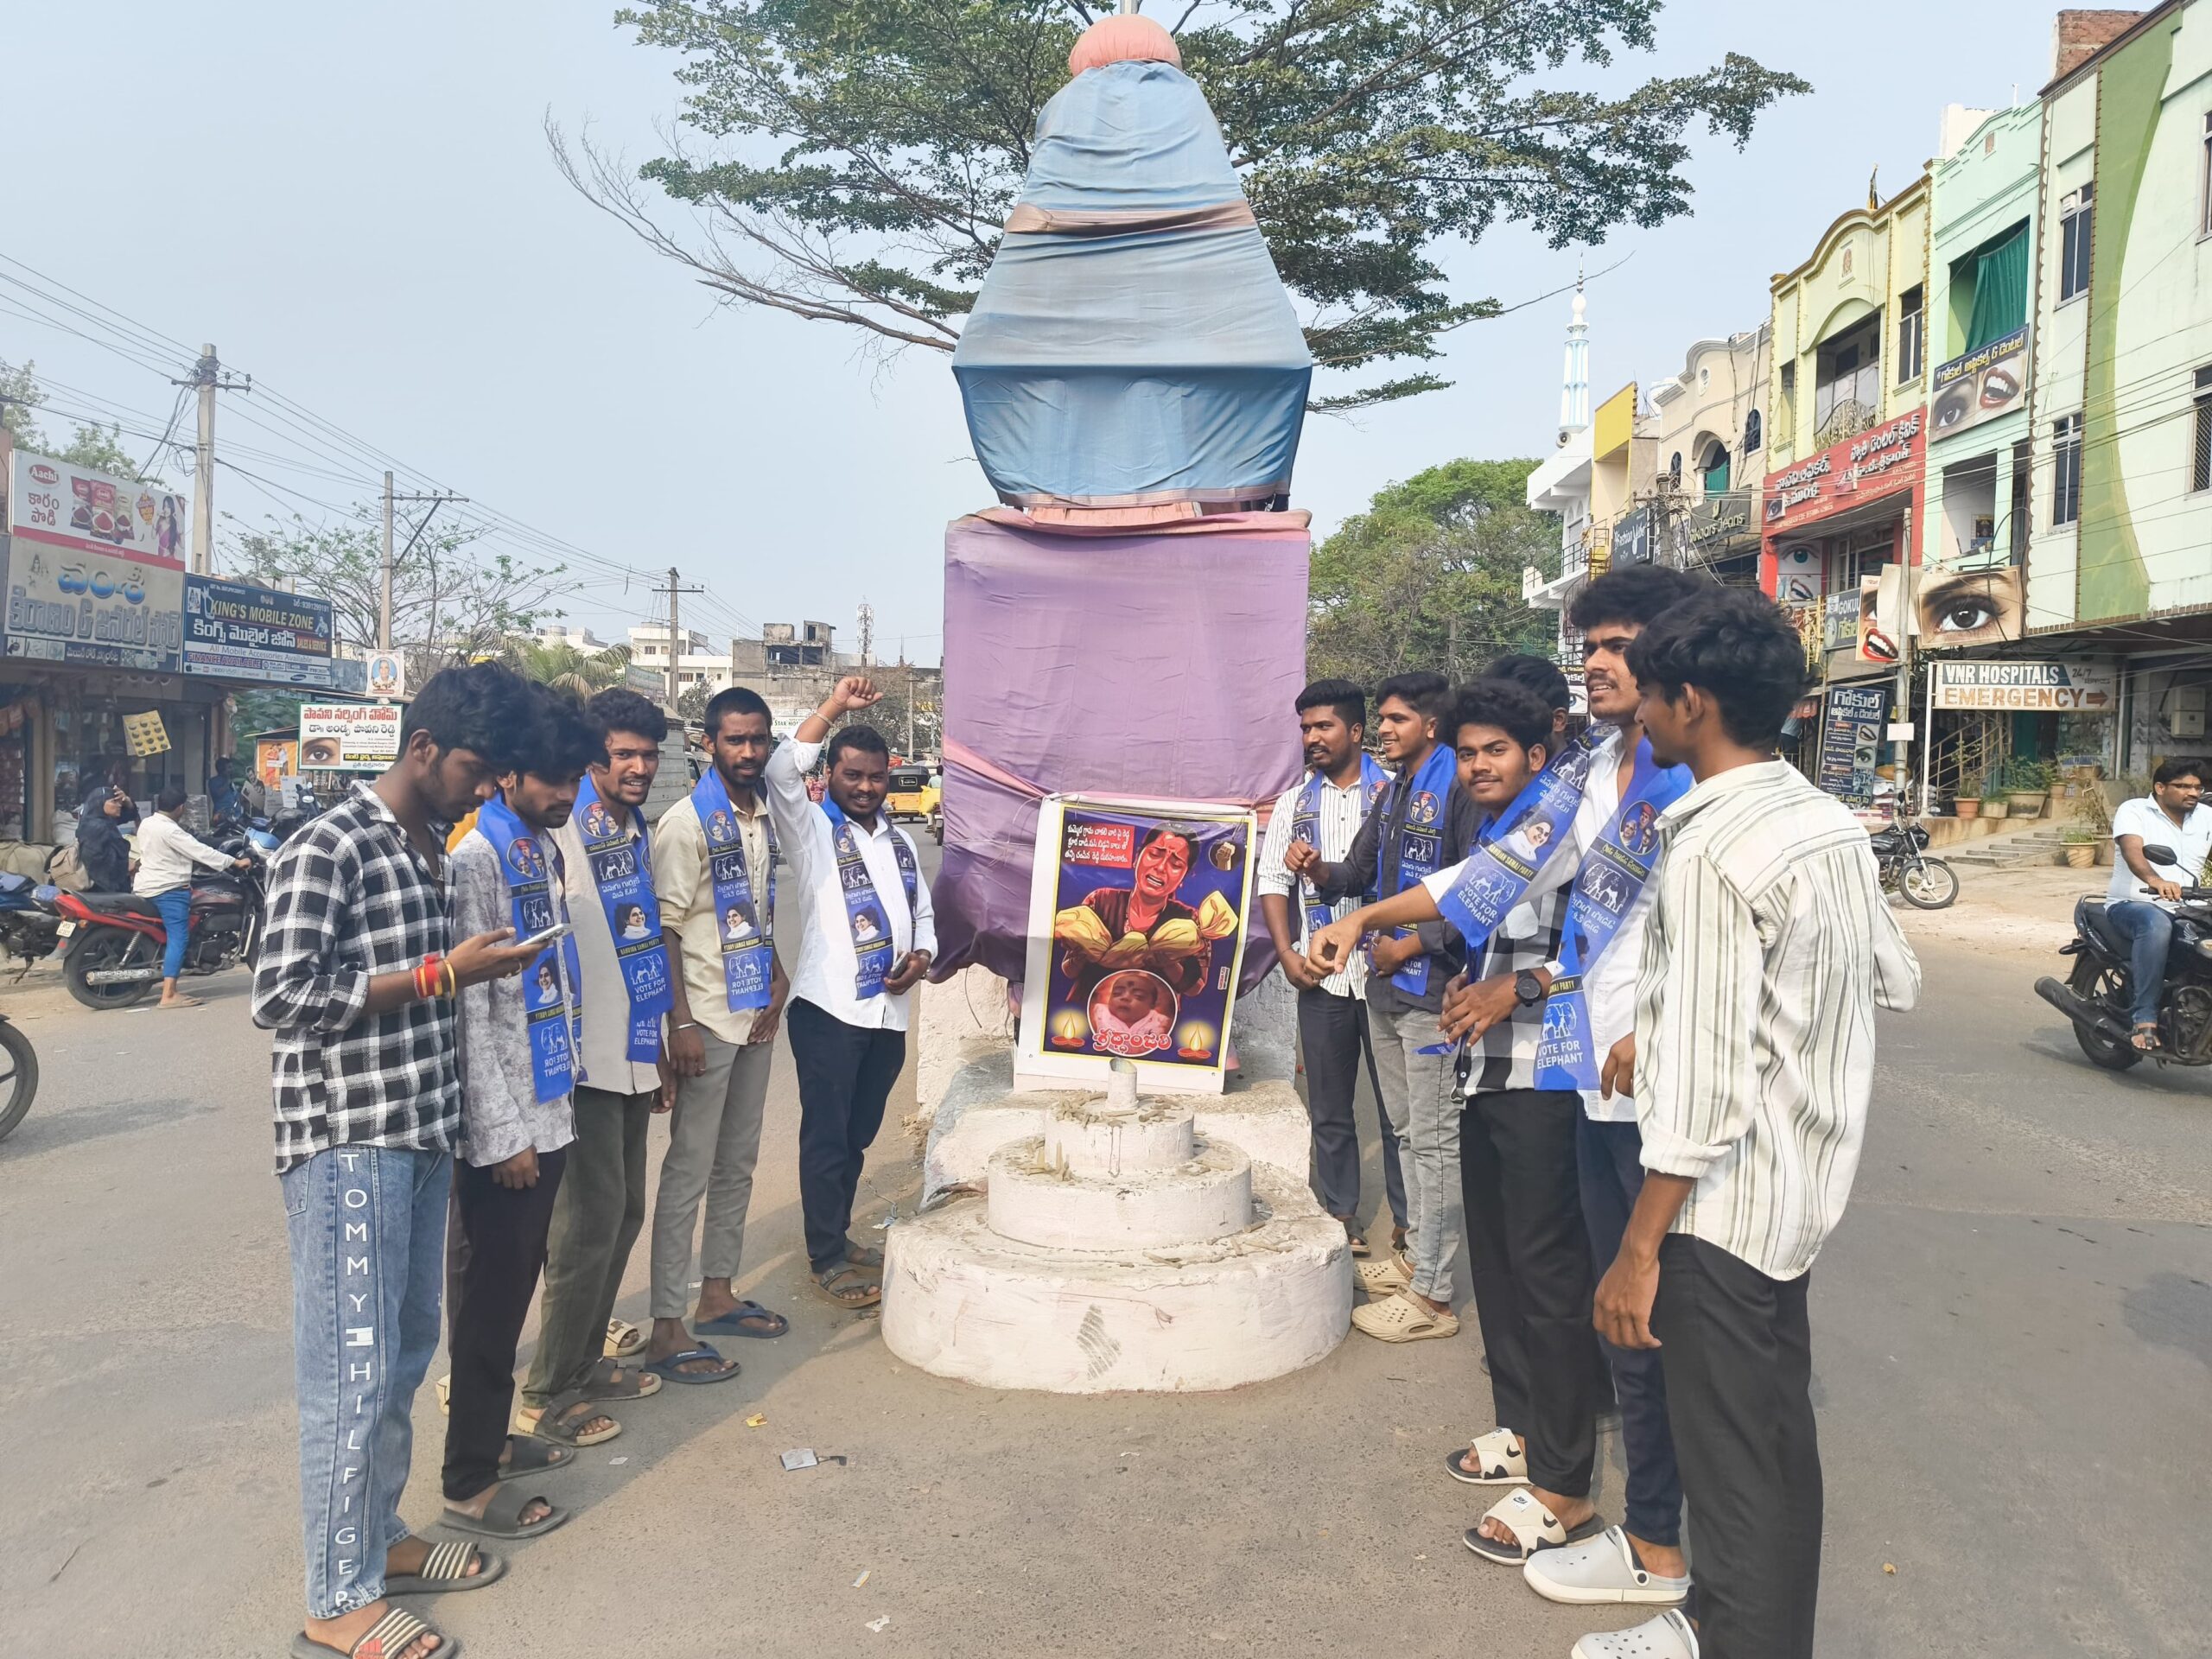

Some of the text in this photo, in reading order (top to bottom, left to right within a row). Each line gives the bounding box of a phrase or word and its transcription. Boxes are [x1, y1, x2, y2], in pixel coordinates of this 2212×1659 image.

[31, 466, 58, 481] Aachi
[28, 492, 60, 510] కారం
[31, 508, 56, 525] పొడి
[58, 563, 145, 605] వంశీ
[211, 600, 247, 620] KING'S
[249, 606, 288, 626] MOBILE
[289, 613, 315, 630] ZONE
[194, 619, 296, 648] కింగ్స్ మొబైల్ జోన్
[187, 652, 262, 668] FINANCE AVAILABLE
[221, 645, 247, 656] Mobile
[248, 649, 283, 660] Accessories
[1945, 664, 2092, 684] VNR HOSPITALS 24/7
[1834, 689, 1881, 709] గోకుల్
[1944, 688, 2085, 708] EMERGENCY
[304, 707, 397, 723] పావని నర్సింగ్ హోమ్
[353, 725, 378, 734] పావని
[381, 724, 396, 737] రెడ్డి
[1505, 856, 1521, 871] SAMAJ
[1518, 865, 1534, 878] PARTY
[1458, 890, 1493, 926] ELEPHANT
[1465, 883, 1497, 918] VOTE FOR
[1409, 959, 1422, 969] FOR
[634, 977, 665, 994] VOTE FOR
[635, 984, 666, 1002] ELEPHANT
[1560, 981, 1574, 991] PARTY
[634, 1037, 658, 1046] ELEPHANT
[1538, 1040, 1580, 1057] VOTE FOR
[1537, 1052, 1583, 1070] ELEPHANT
[334, 1153, 372, 1606] TOMMY HILFIGER
